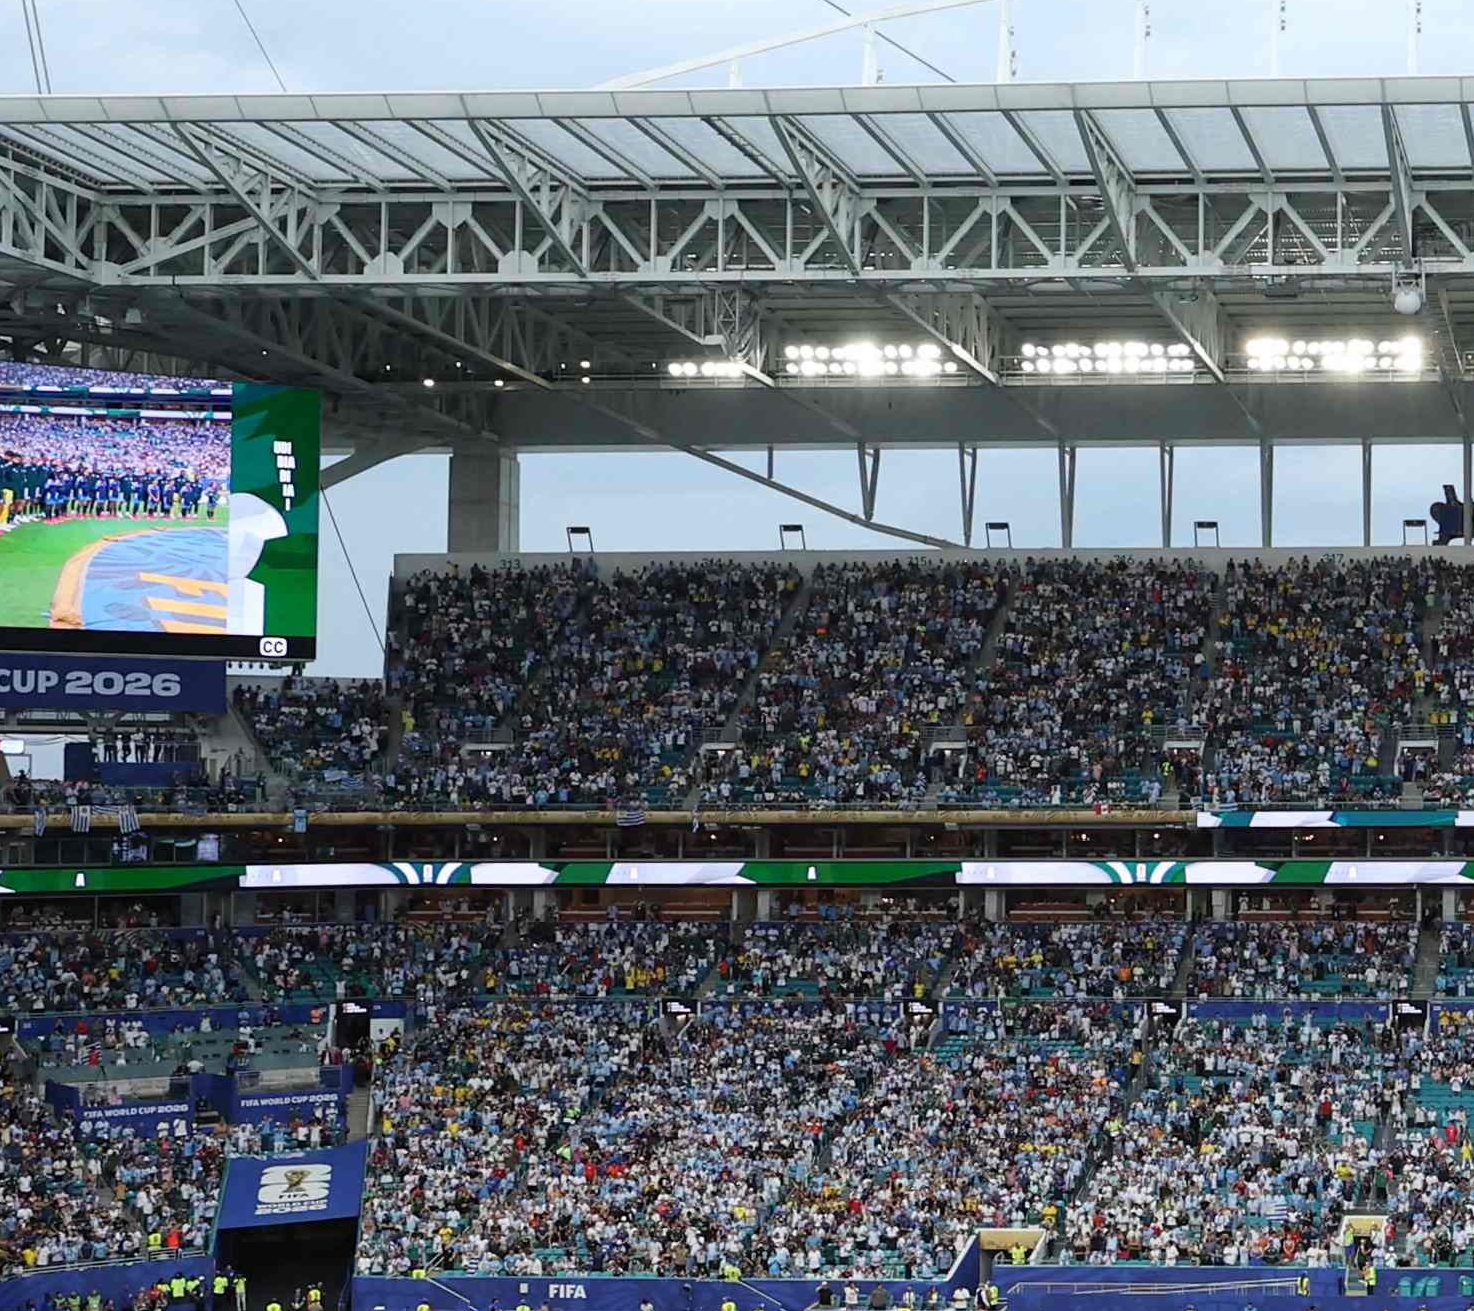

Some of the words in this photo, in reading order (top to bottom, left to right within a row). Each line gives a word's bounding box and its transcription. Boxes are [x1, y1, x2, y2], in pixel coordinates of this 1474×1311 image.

[263, 641, 284, 654] CC
[64, 671, 181, 697] 2026
[241, 1099, 259, 1107] FIFA
[260, 1098, 290, 1106] WORLD
[291, 1096, 307, 1104] CUP
[308, 1094, 338, 1104] 2026
[104, 1108, 138, 1117] WORLD
[139, 1107, 157, 1115] CUP
[157, 1104, 189, 1114] 2026
[548, 1283, 587, 1300] FIFA
